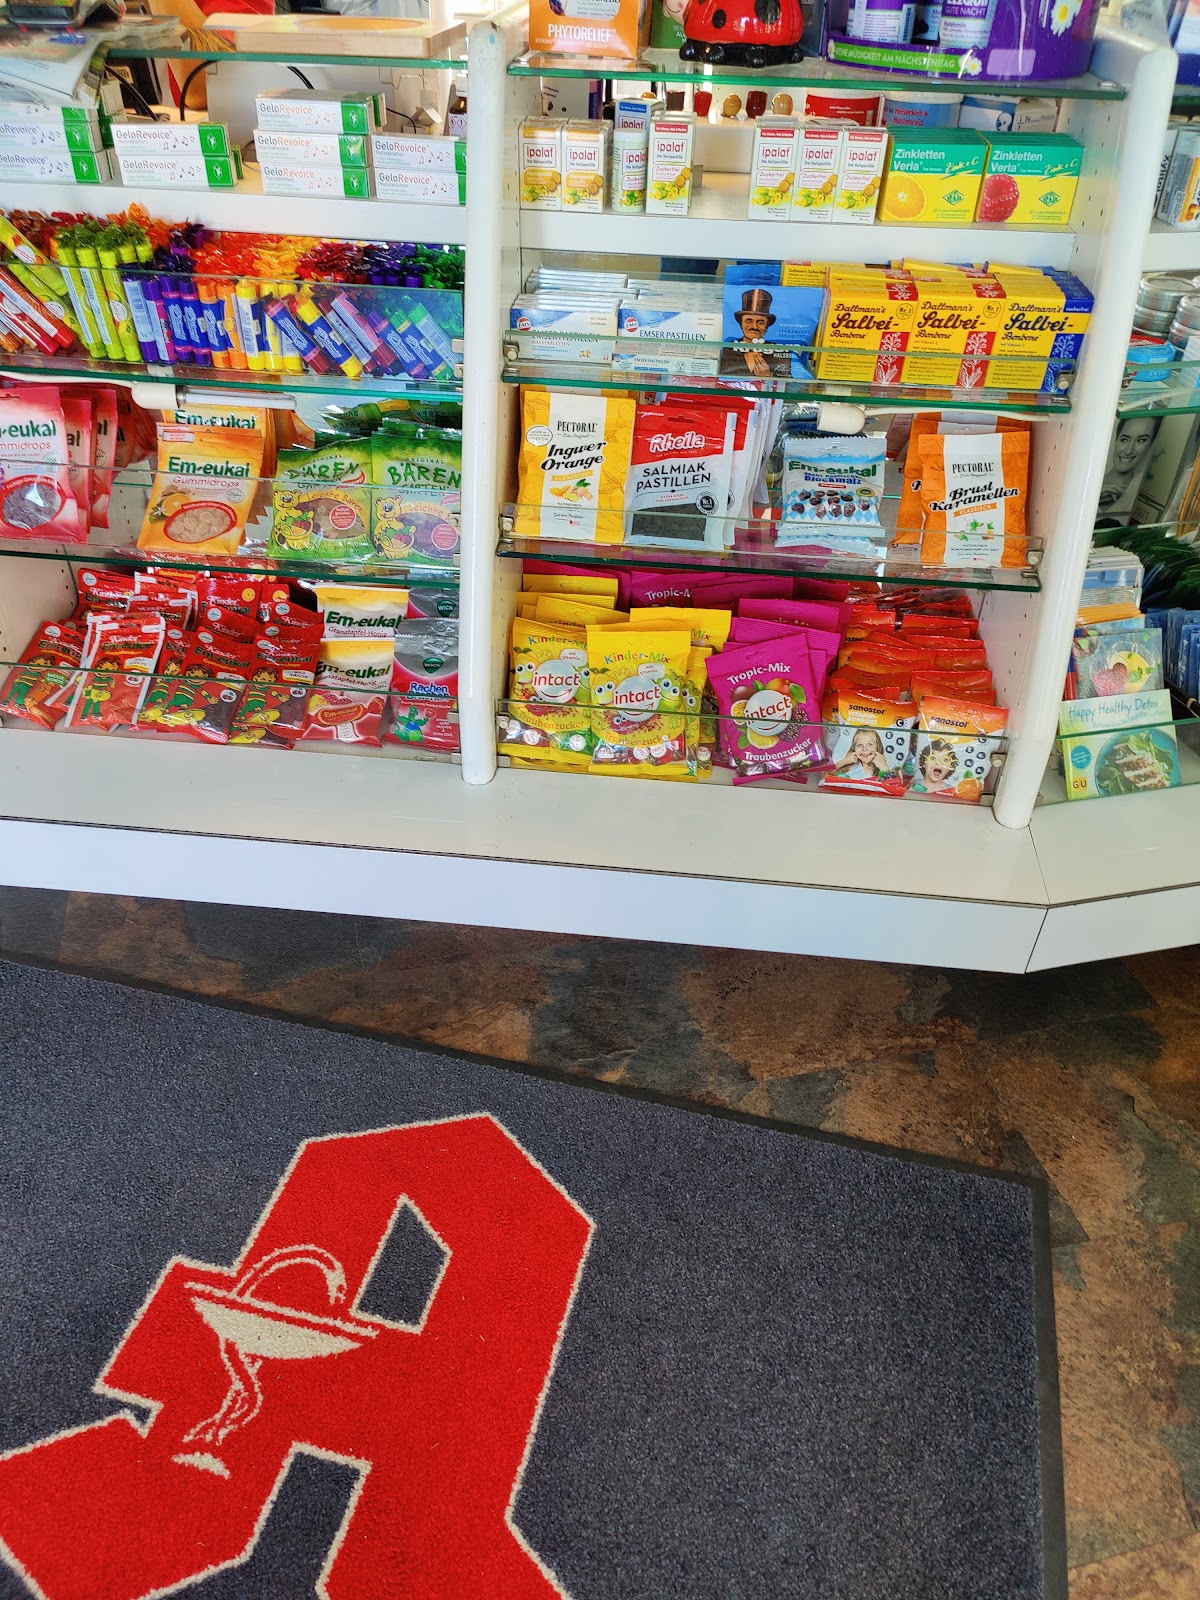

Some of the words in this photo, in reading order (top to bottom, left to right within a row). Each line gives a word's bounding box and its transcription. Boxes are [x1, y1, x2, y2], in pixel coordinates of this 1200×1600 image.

[960, 6, 987, 17] NACHT
[547, 23, 613, 43] PHYTORELIEF
[849, 47, 882, 62] MÜDIGKEIT
[881, 54, 895, 62] AM
[258, 102, 314, 114] GeloRevoice
[115, 129, 171, 140] GeloRevoice
[257, 135, 312, 147] GeloRevoice
[374, 140, 428, 153] GeloRevoice
[526, 146, 553, 159] ipalat
[656, 140, 685, 153] ipalat
[761, 146, 791, 159] ipalat
[569, 148, 597, 162] ipalat
[805, 148, 834, 160] ipalat
[848, 150, 877, 162] ipalat
[894, 148, 946, 160] Zinkletten
[992, 150, 1043, 162] Zinkletten
[122, 159, 178, 170] GeloRevoice
[893, 160, 919, 172] Verla
[991, 161, 1018, 173] Verla
[263, 166, 316, 179] GeloRevoice
[378, 172, 431, 185] GeloRevoice
[834, 303, 887, 313] Dallmann's
[920, 301, 974, 312] Dallmann's
[1008, 302, 1063, 313] Dallmann's
[831, 312, 899, 331] Salbei-
[917, 311, 986, 330] Salbei-
[1004, 312, 1074, 332] Salbei-
[639, 329, 665, 339] EMSER
[665, 331, 706, 341] PASTILLEN
[829, 329, 867, 339] Bonbons
[914, 329, 953, 339] Bonbons
[1001, 331, 1040, 342] Bonbons
[556, 420, 597, 433] PECTORAL
[649, 430, 706, 453] Rheila
[547, 441, 607, 460] Ingwer
[168, 456, 250, 478] Em-eukal
[540, 455, 604, 471] Orange
[642, 461, 706, 478] SALMIAK
[788, 460, 877, 478] Em-eukal
[951, 462, 994, 475] PECTORAL
[172, 476, 240, 488] Gummidrops
[387, 462, 461, 489] BÄREN
[636, 472, 711, 492] PASTILLEN
[803, 475, 862, 485] Blockmalz
[949, 481, 993, 502] Brust
[929, 487, 1019, 511] Karamellen
[959, 504, 993, 516] KLASSISCH
[207, 595, 240, 606] Kinder
[438, 604, 455, 613] WICK
[326, 611, 403, 630] Em-eukal
[194, 646, 251, 669] Em-eukal
[204, 643, 240, 660] Kinder
[603, 650, 671, 665] Kinder-Mix
[314, 660, 392, 679] Em-eukal
[726, 662, 792, 686] Tropic-Mix
[533, 671, 580, 686] intact
[410, 682, 449, 694] Rachen
[614, 686, 661, 705] intact
[744, 696, 792, 725] intact
[848, 703, 887, 715] sanostol
[1068, 705, 1096, 723] Happy
[1098, 699, 1133, 719] Healthy
[1134, 698, 1159, 711] Detox
[518, 711, 585, 730] Traubenzucker
[930, 715, 969, 729] sanostol
[604, 731, 672, 746] Traubenzucer
[744, 737, 812, 761] Traubenzucker
